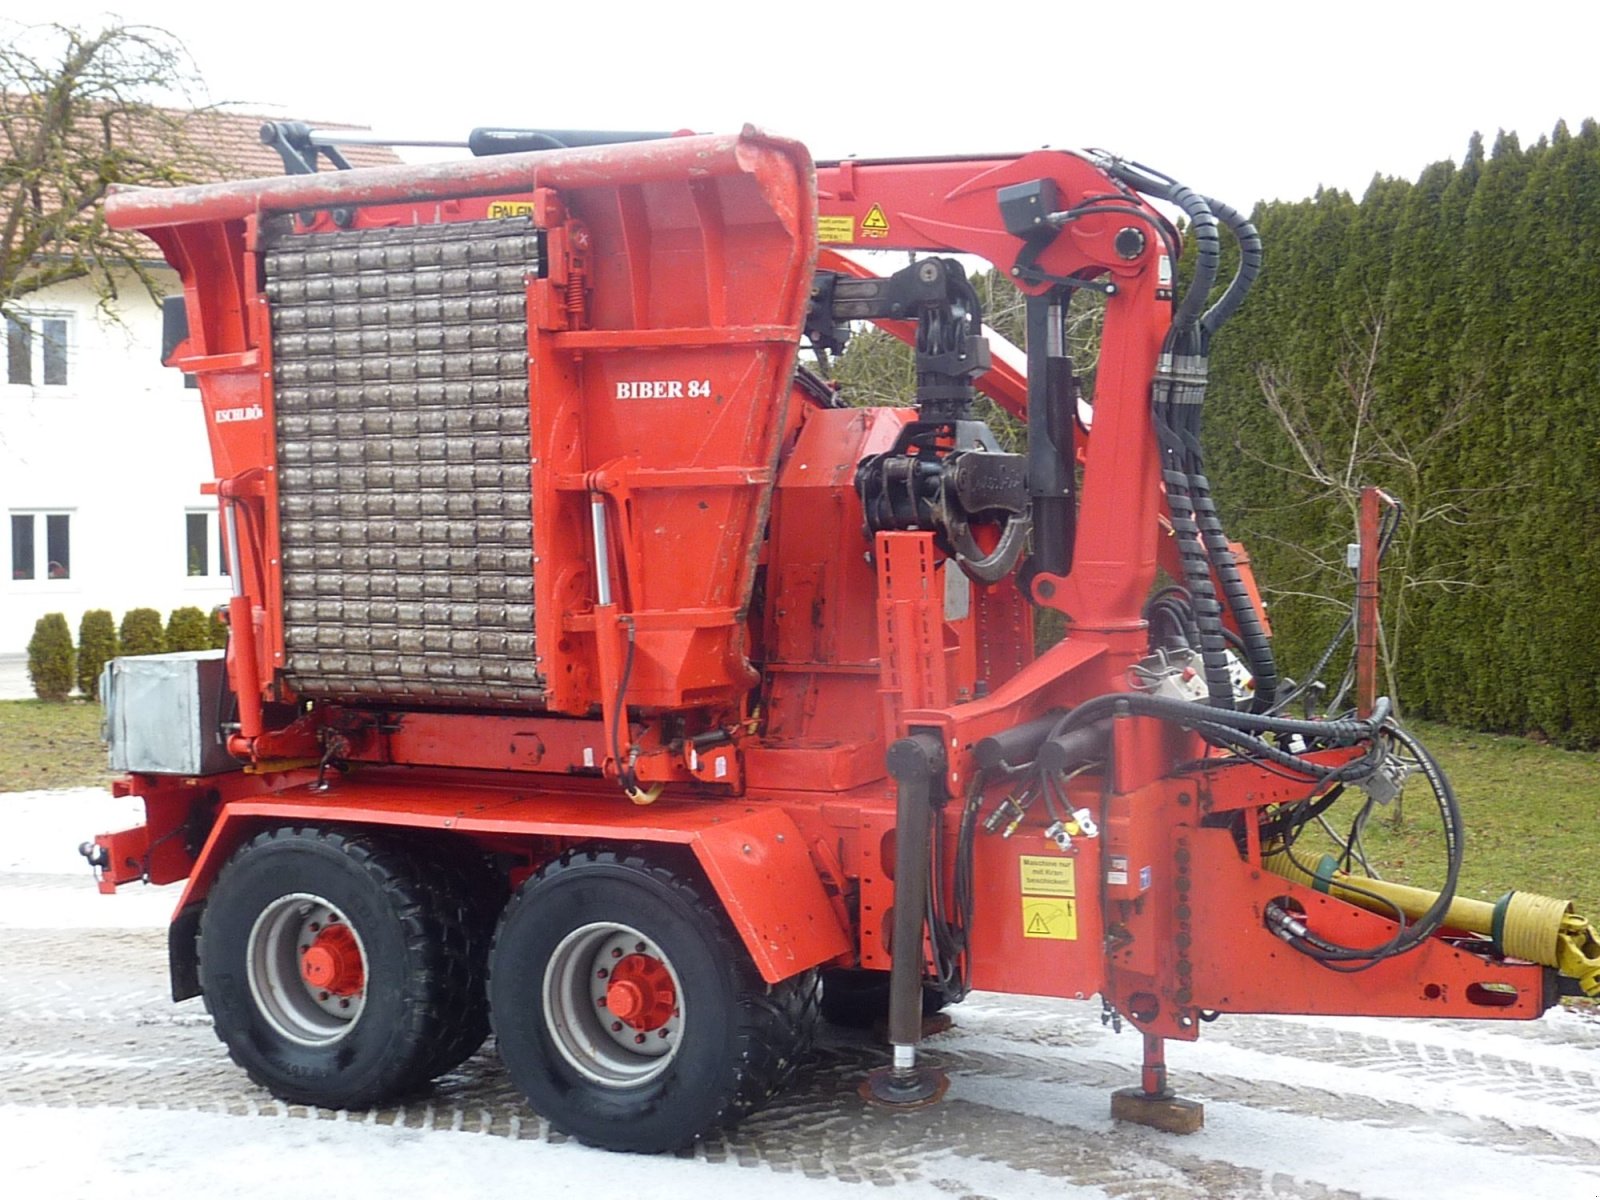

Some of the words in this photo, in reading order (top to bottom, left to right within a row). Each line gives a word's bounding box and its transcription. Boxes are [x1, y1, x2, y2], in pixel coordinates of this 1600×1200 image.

[616, 381, 684, 399] BIBER
[687, 379, 711, 398] 84
[1023, 859, 1057, 867] Maschine
